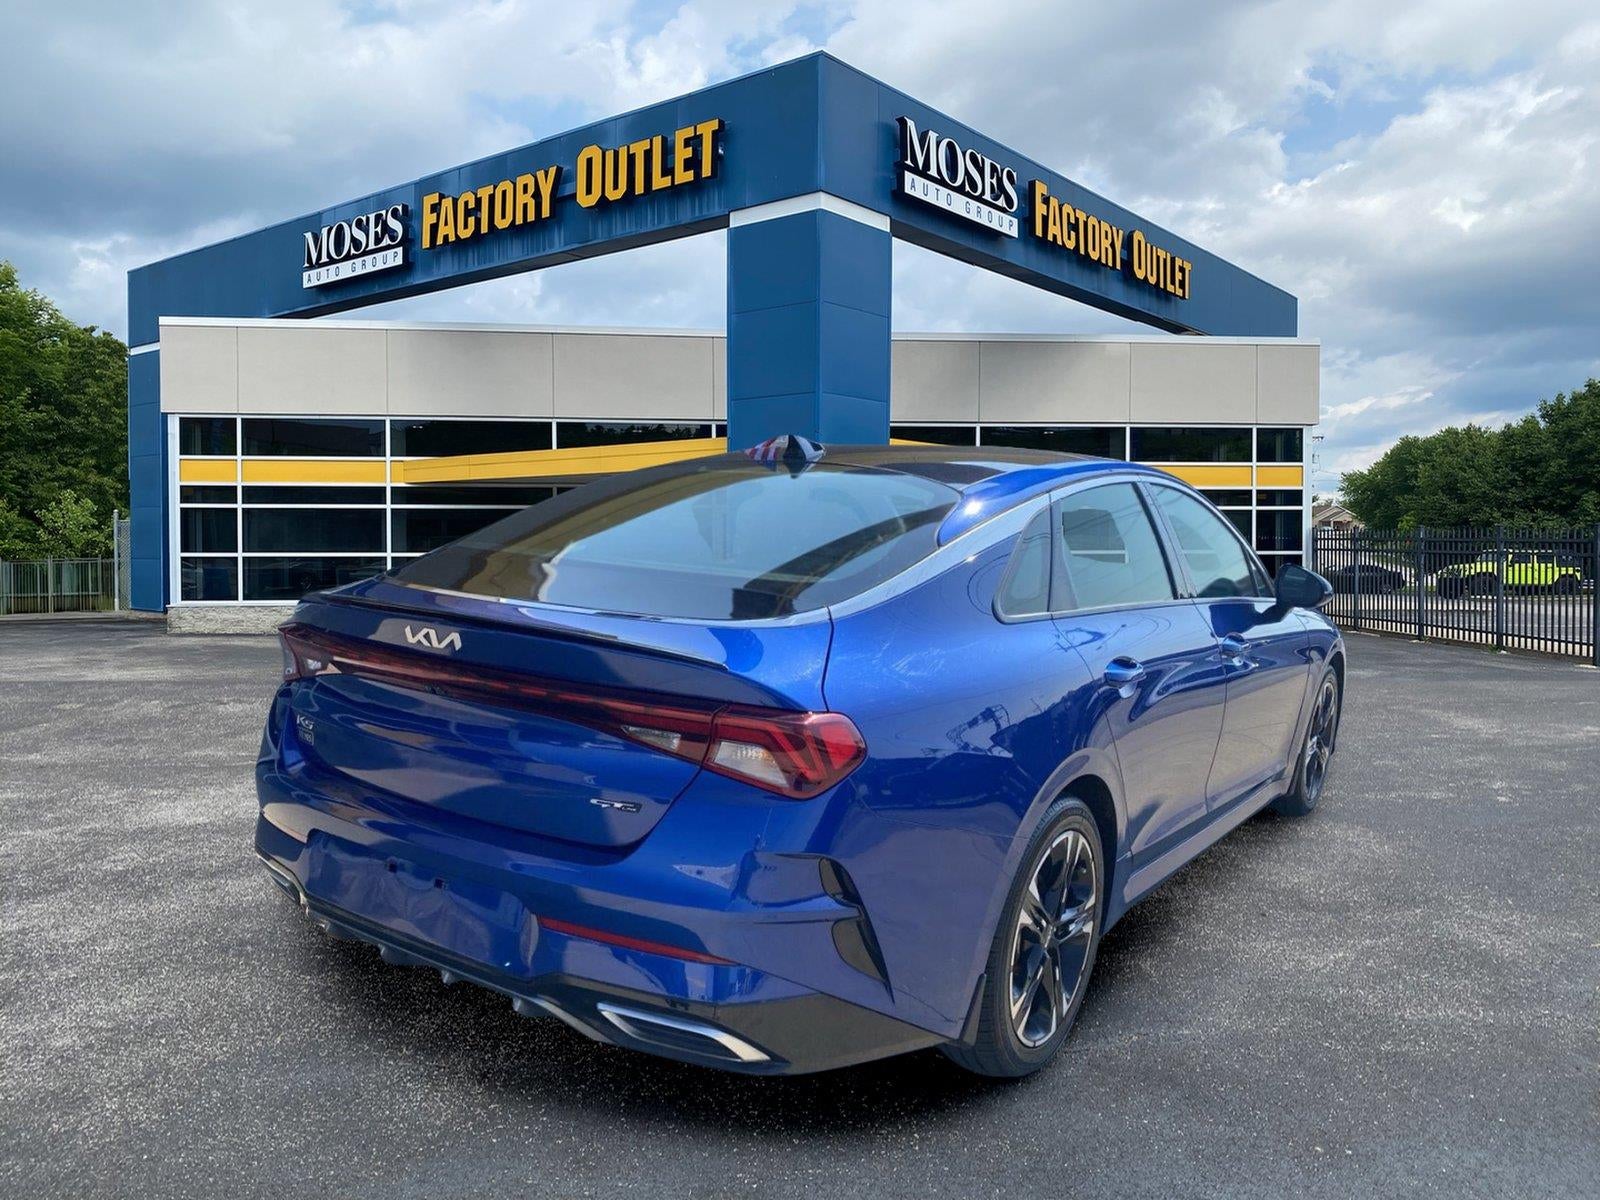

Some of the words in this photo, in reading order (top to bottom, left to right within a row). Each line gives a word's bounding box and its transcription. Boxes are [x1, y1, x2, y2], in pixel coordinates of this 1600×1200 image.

[422, 165, 558, 249] FACTORY
[576, 118, 719, 208] OUTLET
[904, 116, 1019, 212] MOSES
[303, 204, 403, 268] MOSES
[909, 177, 953, 206] AUTO
[965, 202, 1014, 232] GROUP
[307, 266, 340, 284] AUTO
[351, 251, 399, 273] GROUP
[1034, 180, 1124, 270] FACTORY
[1132, 229, 1192, 299] OUTLET
[405, 625, 462, 651] KIA
